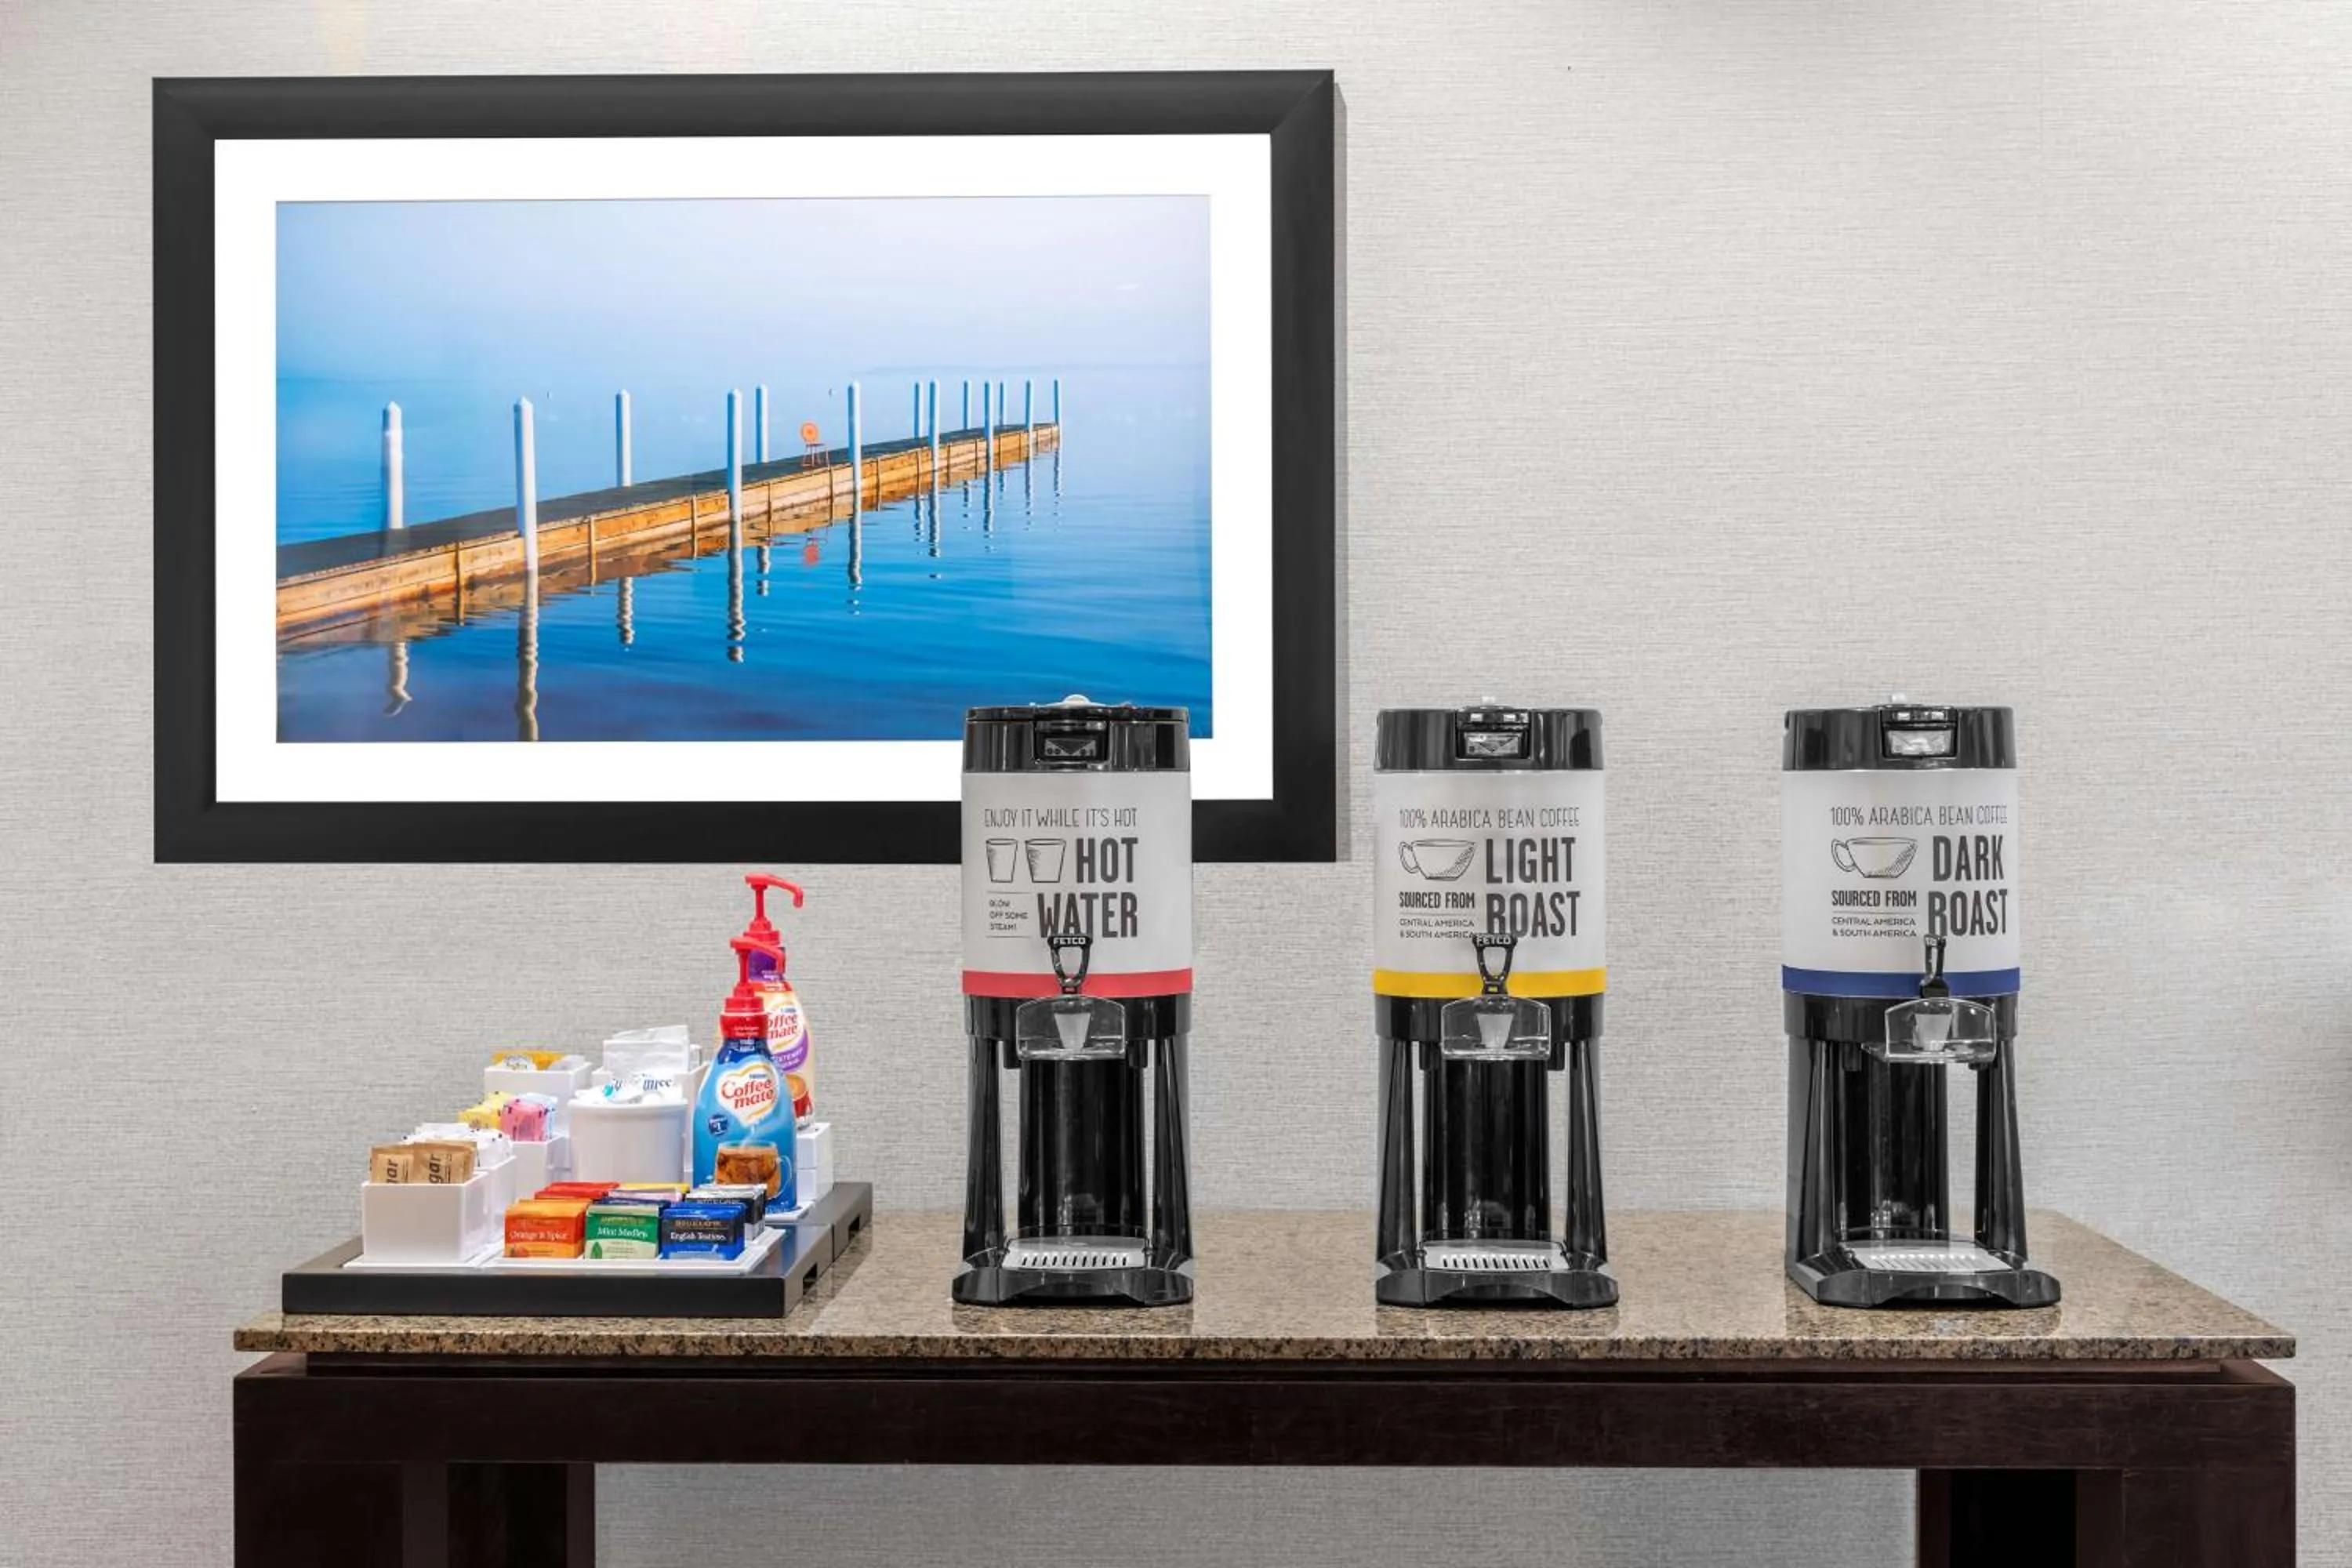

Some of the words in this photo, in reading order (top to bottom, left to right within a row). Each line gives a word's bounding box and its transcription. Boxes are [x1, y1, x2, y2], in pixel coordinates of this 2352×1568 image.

[985, 808, 1018, 827] ENJOY
[1022, 809, 1032, 827] IT
[1036, 809, 1079, 827] WHILE
[1086, 809, 1109, 827] IT'S
[1114, 808, 1138, 826] HOT
[1399, 808, 1427, 828] 100%
[1431, 809, 1491, 829] ARABICA
[1498, 808, 1534, 829] BEAN
[1540, 807, 1581, 827] COFFEE
[1831, 807, 1864, 826] 100%
[1869, 807, 1933, 826] ARABICA
[1939, 806, 1973, 825] BEAN
[1976, 805, 2007, 824] COFFEE
[1076, 837, 1139, 884] HOT
[1486, 837, 1576, 884] LIGHT
[1933, 835, 2005, 882] DARK
[1399, 891, 1441, 909] SOURCED
[1445, 891, 1475, 909] FROM
[1831, 890, 1881, 907] SOURCED
[1885, 890, 1917, 907] FROM
[1037, 891, 1139, 938] WATER
[1399, 918, 1433, 927] CENTRAL
[1435, 919, 1475, 927] AMERICA
[1486, 891, 1581, 938] ROAST
[1831, 916, 1871, 926] CENTRAL
[1873, 917, 1916, 926] AMERICA
[1928, 888, 2008, 937] ROAST
[1434, 931, 1475, 939] AMERICA
[1840, 929, 1870, 938] SOUTH
[1871, 929, 1917, 938] AMERICA
[768, 1013, 797, 1029] offee
[721, 1079, 772, 1099] Coffee
[733, 1089, 774, 1109] mate
[670, 1232, 696, 1242] English
